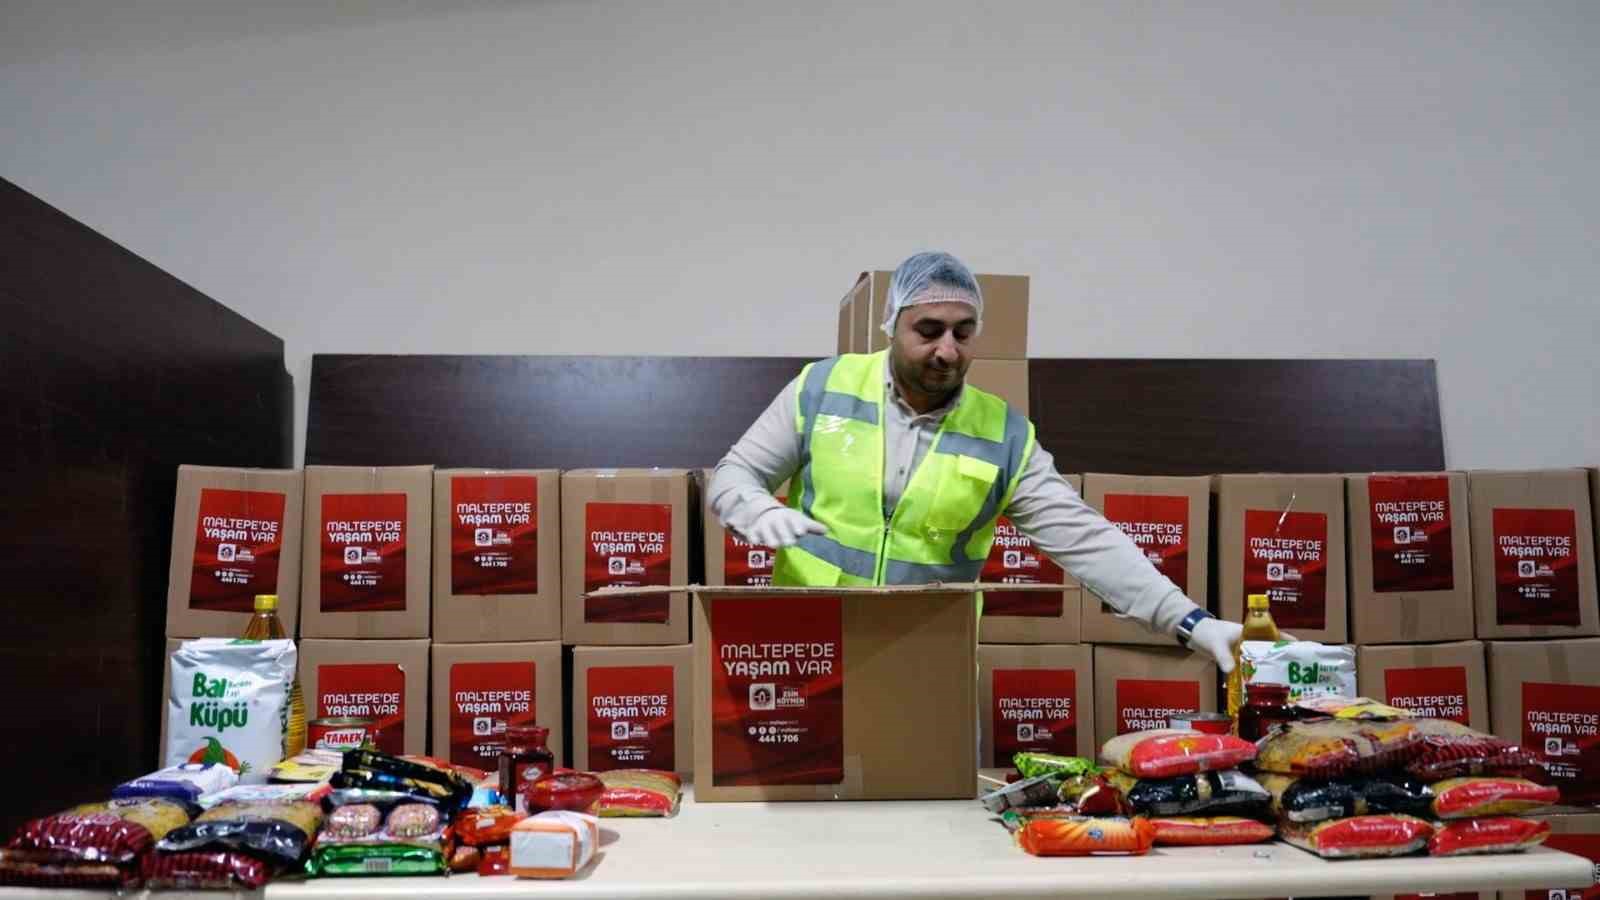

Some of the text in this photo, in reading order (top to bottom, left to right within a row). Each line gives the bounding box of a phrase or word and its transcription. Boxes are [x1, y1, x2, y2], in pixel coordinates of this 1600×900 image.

[457, 503, 531, 513] MALTEPE'DE
[1375, 500, 1444, 512] MALTEPE'DE
[458, 514, 529, 526] YAŞAM VAR
[1376, 511, 1444, 524] YAŞAM VAR
[202, 516, 278, 532] MALTEPE'DE
[327, 521, 401, 532] MALTEPE'DE
[204, 527, 276, 542] YAŞAM VAR
[329, 532, 399, 544] YAŞAM VAR
[591, 531, 665, 542] MALTEPE'DE
[1157, 534, 1182, 545] VAR
[1499, 535, 1571, 546] MALTEPE'DE
[592, 542, 663, 555] YAŞAM VAR
[1250, 537, 1321, 550] MALTEPE'DE
[1252, 548, 1320, 561] YAŞAM VAR
[1502, 546, 1570, 558] YAŞAM VAR
[720, 643, 835, 659] MALTEPE'DE
[724, 661, 833, 679] YAŞAM VAR
[1288, 661, 1318, 684] Bal
[192, 671, 227, 698] Bal
[323, 693, 400, 704] MALTEPE'DE
[455, 691, 531, 701] MALTEPE'DE
[592, 695, 668, 706] MALTEPE'DE
[457, 702, 529, 715] YAŞAM VAR
[999, 698, 1071, 708] MALTEPE'DE
[190, 701, 248, 733] Küpü
[325, 704, 398, 719] YAŞAM VAR
[595, 707, 666, 719] YAŞAM VAR
[1001, 709, 1070, 721] YAŞAM VAR
[1440, 706, 1463, 717] VAR
[1528, 711, 1599, 725] MALTEPE'DE
[1530, 722, 1598, 736] YAŞAM VAR
[326, 733, 363, 745] TAMEK
